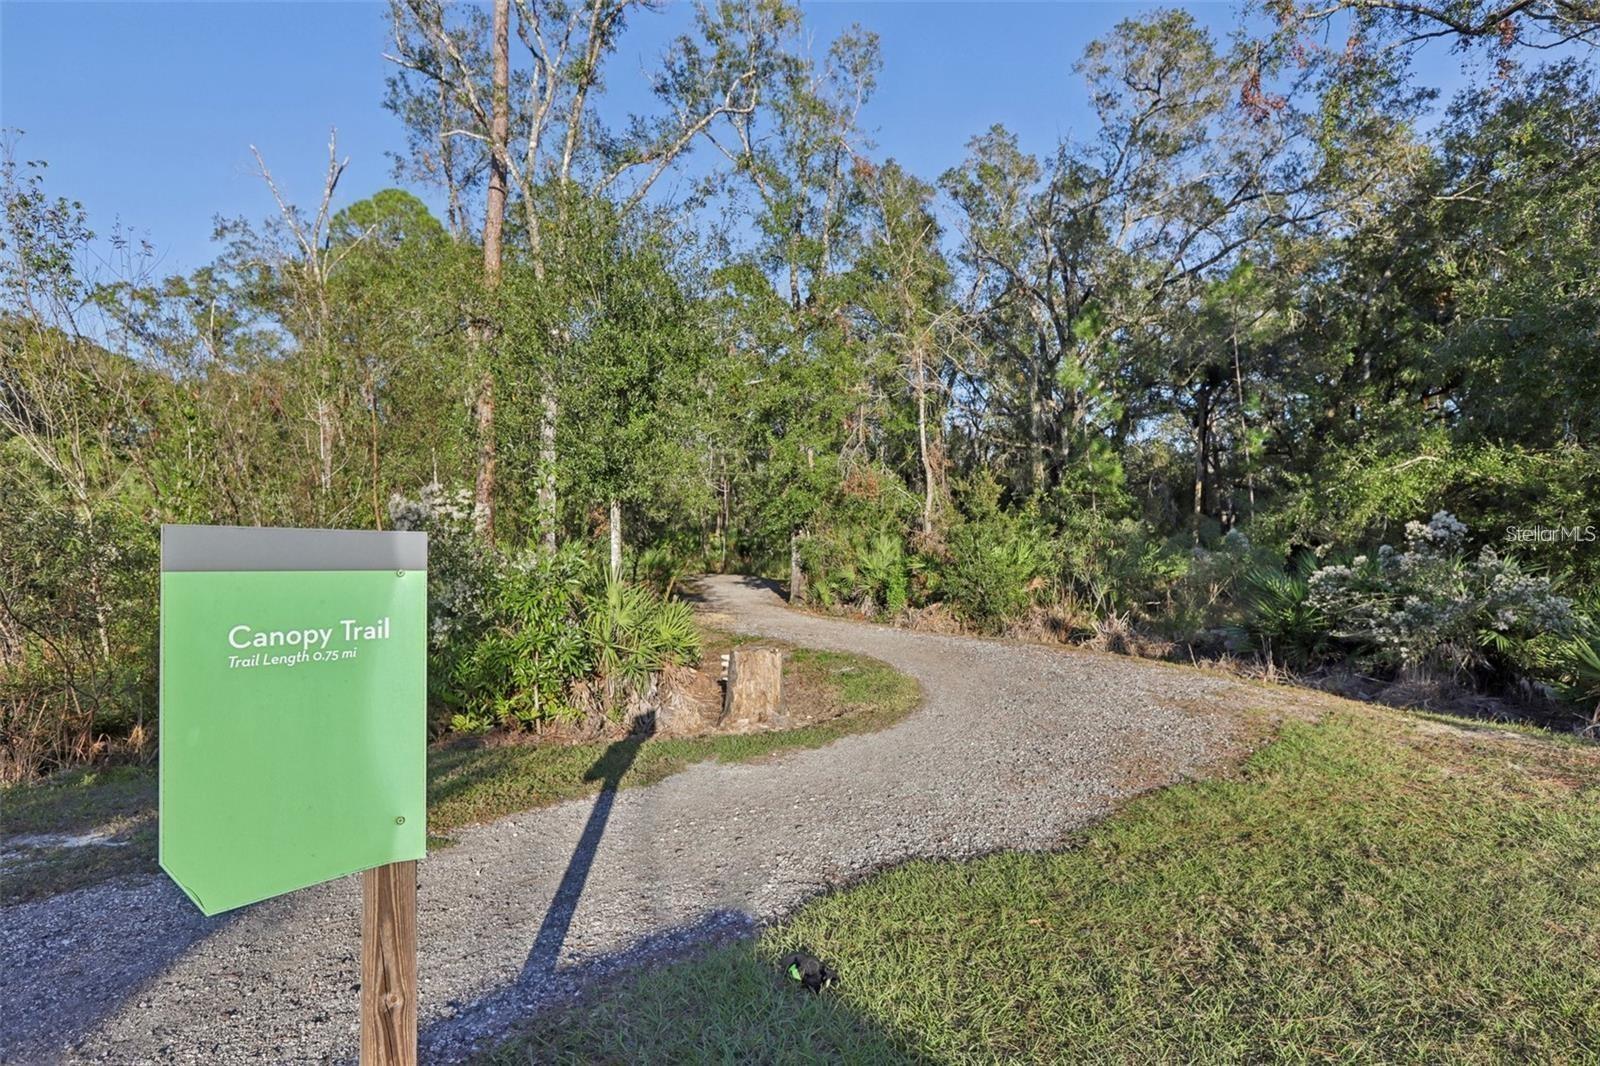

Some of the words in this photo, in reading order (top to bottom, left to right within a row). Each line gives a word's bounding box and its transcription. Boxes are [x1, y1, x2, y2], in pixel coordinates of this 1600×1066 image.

[228, 624, 333, 650] Canopy
[340, 617, 390, 641] Trail
[228, 653, 260, 668] Trail
[262, 650, 310, 667] Length
[313, 650, 339, 662] 0.75
[341, 647, 357, 659] mi
